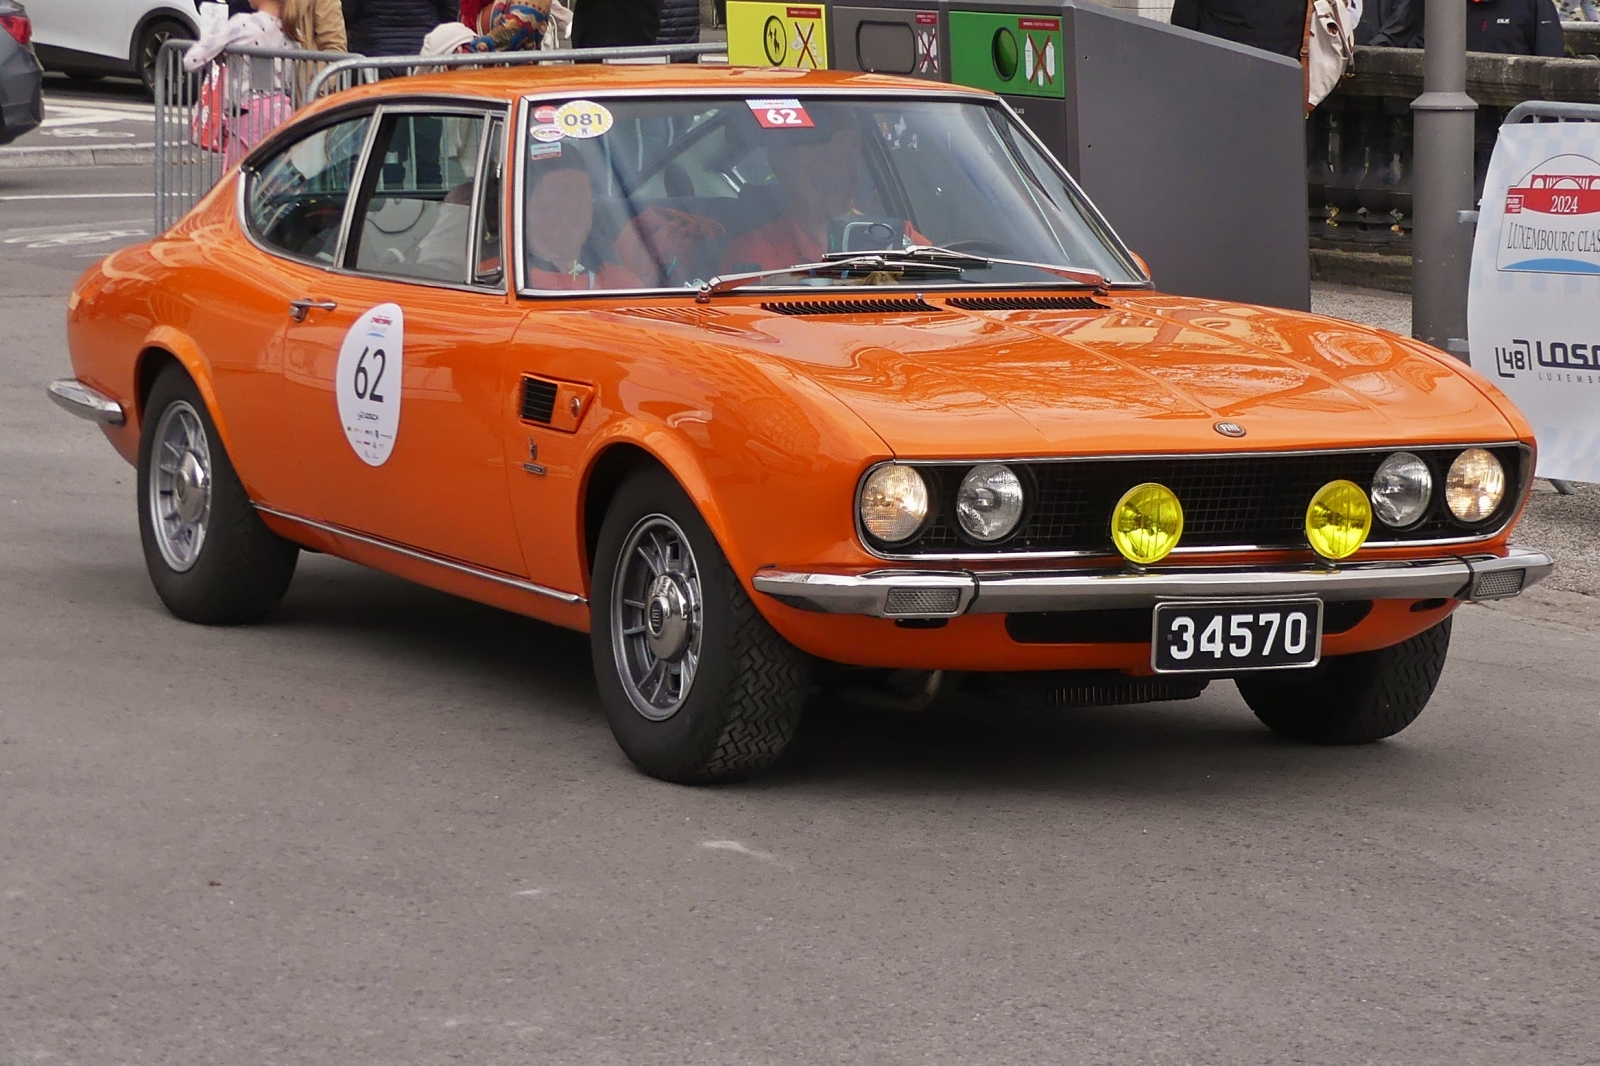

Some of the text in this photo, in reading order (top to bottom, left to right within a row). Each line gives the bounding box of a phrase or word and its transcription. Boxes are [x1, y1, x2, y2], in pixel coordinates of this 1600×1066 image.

[564, 113, 603, 126] 081
[767, 109, 803, 125] 62
[1550, 195, 1578, 213] 2024
[1507, 222, 1575, 252] LUXEMBOURG
[1502, 347, 1525, 370] 48
[354, 346, 387, 403] 62
[1170, 611, 1308, 660] 34570
